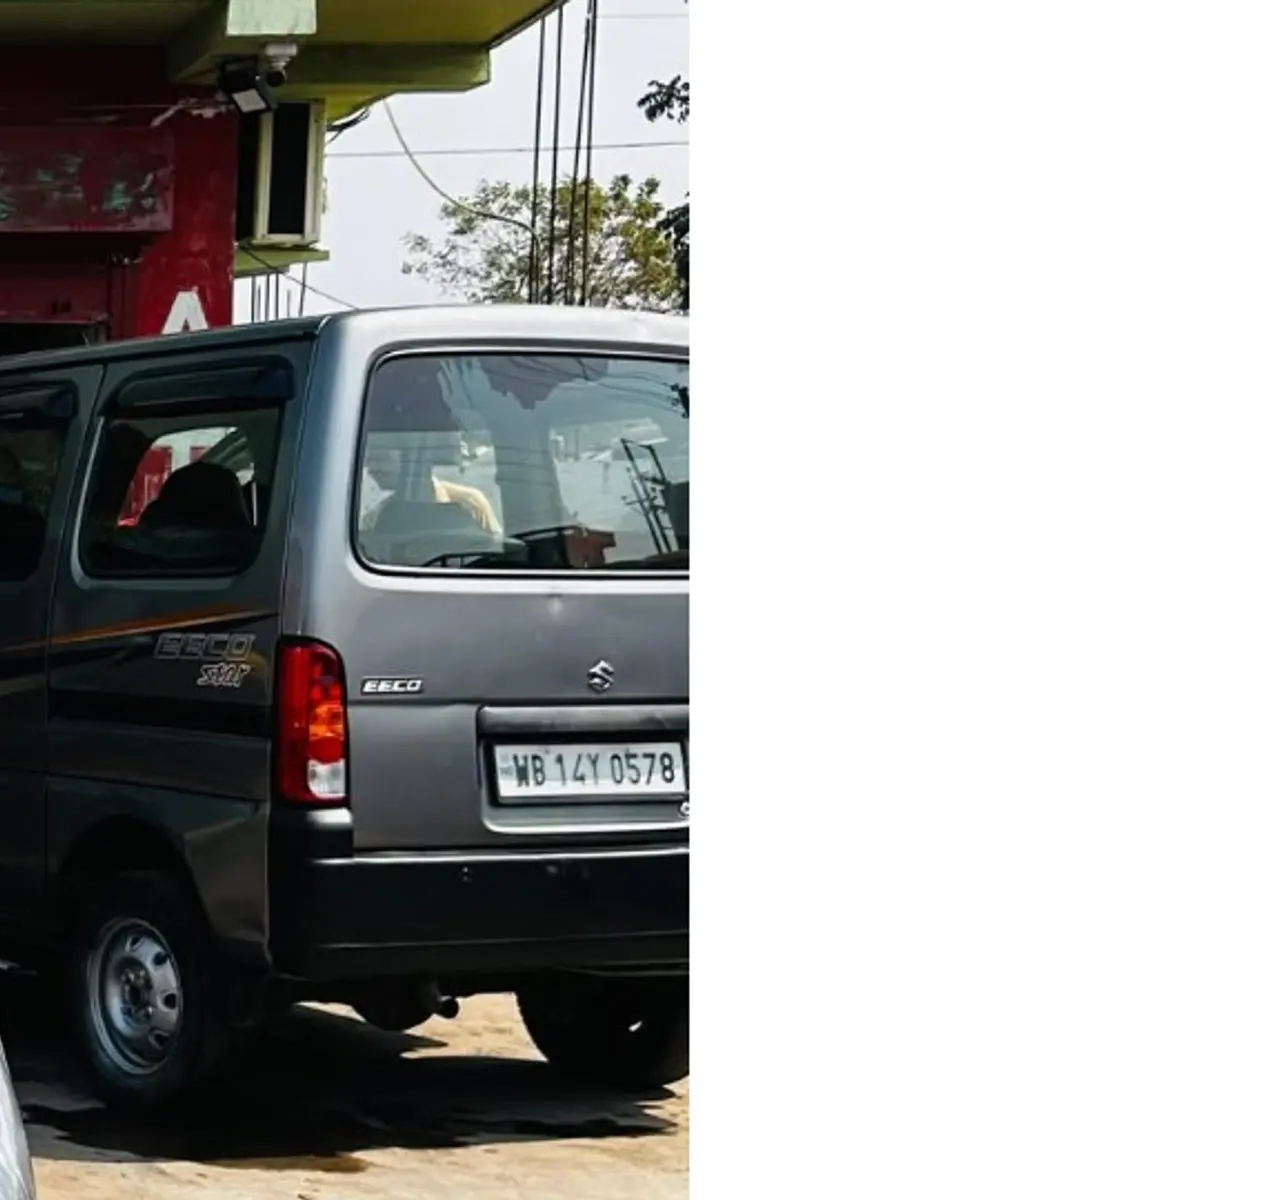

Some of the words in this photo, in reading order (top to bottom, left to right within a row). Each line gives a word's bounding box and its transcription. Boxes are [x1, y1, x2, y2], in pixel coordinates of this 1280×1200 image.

[154, 632, 256, 661] EECO
[362, 679, 422, 693] EECO
[513, 753, 546, 787] WB
[609, 751, 675, 786] 0578
